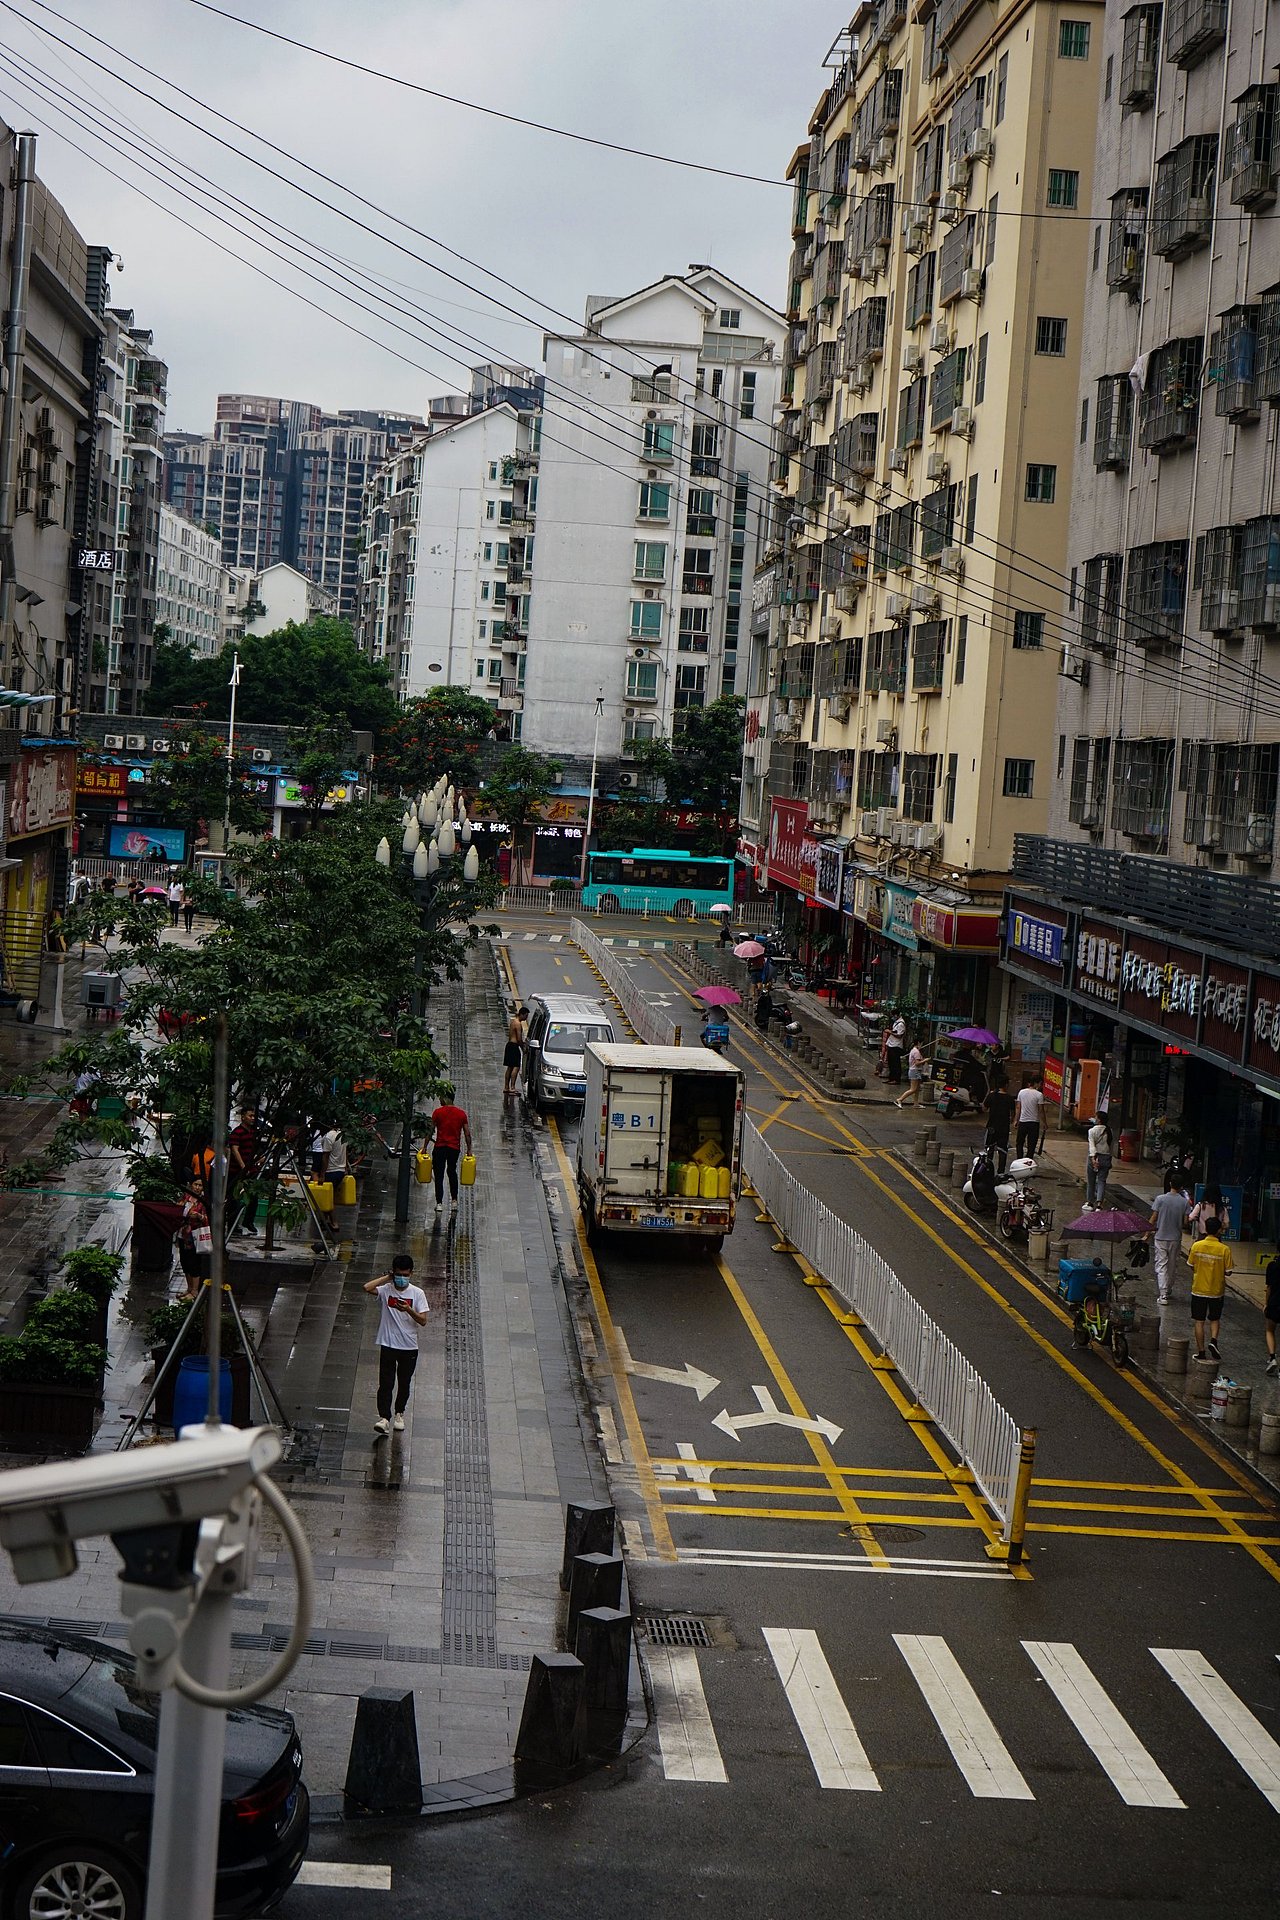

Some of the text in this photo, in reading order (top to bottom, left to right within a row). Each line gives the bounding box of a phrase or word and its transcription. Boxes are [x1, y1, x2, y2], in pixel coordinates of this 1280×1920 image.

[79, 549, 113, 569] 酒店
[610, 1112, 656, 1129] 粤 B 1
